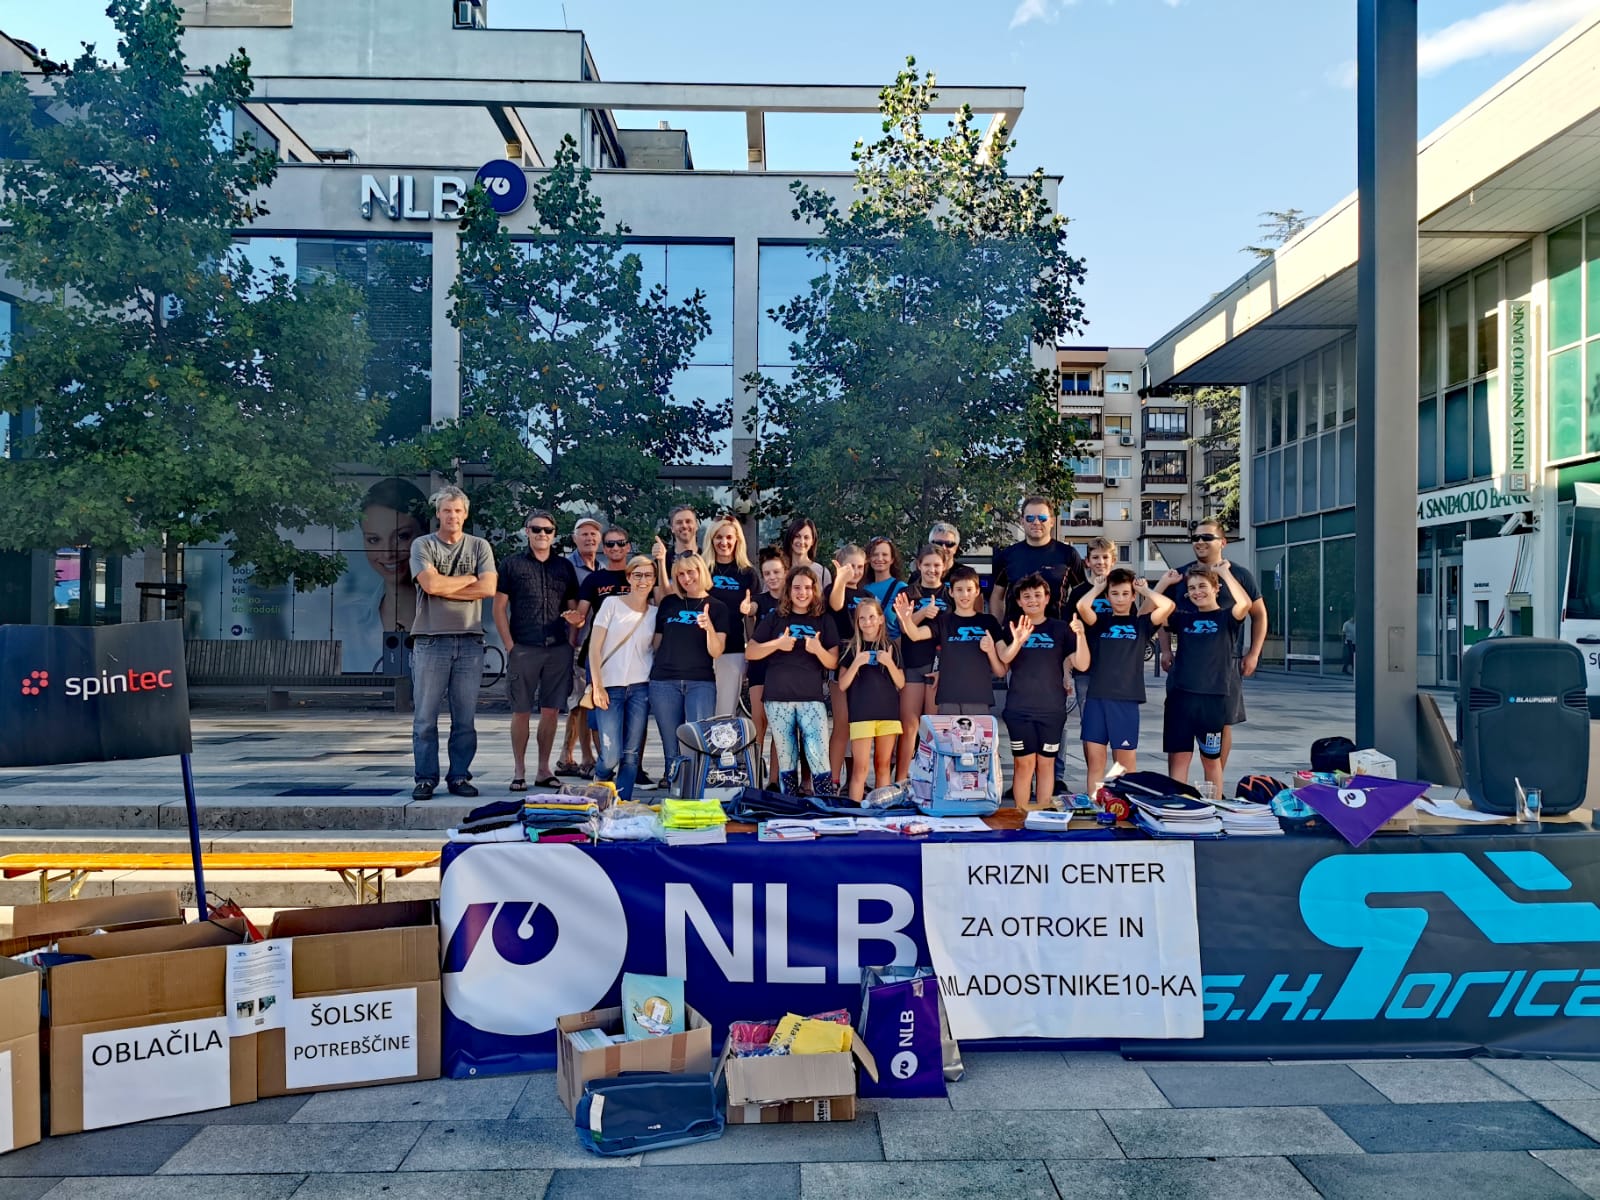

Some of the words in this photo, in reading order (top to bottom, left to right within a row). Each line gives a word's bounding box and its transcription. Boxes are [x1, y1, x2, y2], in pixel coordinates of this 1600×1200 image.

[361, 174, 468, 221] NLB
[1512, 305, 1525, 344] BANK
[1512, 347, 1525, 418] SANPAOLO
[1512, 422, 1525, 470] INTESA
[1426, 489, 1488, 519] SANPAOLO
[65, 668, 173, 701] spintec
[1515, 695, 1558, 703] BLAUPUNKT
[967, 863, 1049, 886] KRIZNI
[1061, 862, 1166, 885] CENTER
[664, 881, 918, 984] NLB
[960, 917, 994, 937] ZA
[1001, 916, 1109, 938] OTROKE
[1119, 916, 1144, 938] IN
[310, 1001, 393, 1027] ŠOLSKE
[899, 1009, 915, 1047] NLB
[92, 1029, 224, 1067] OBLAČILA
[293, 1034, 411, 1061] POTREBŠČINE
